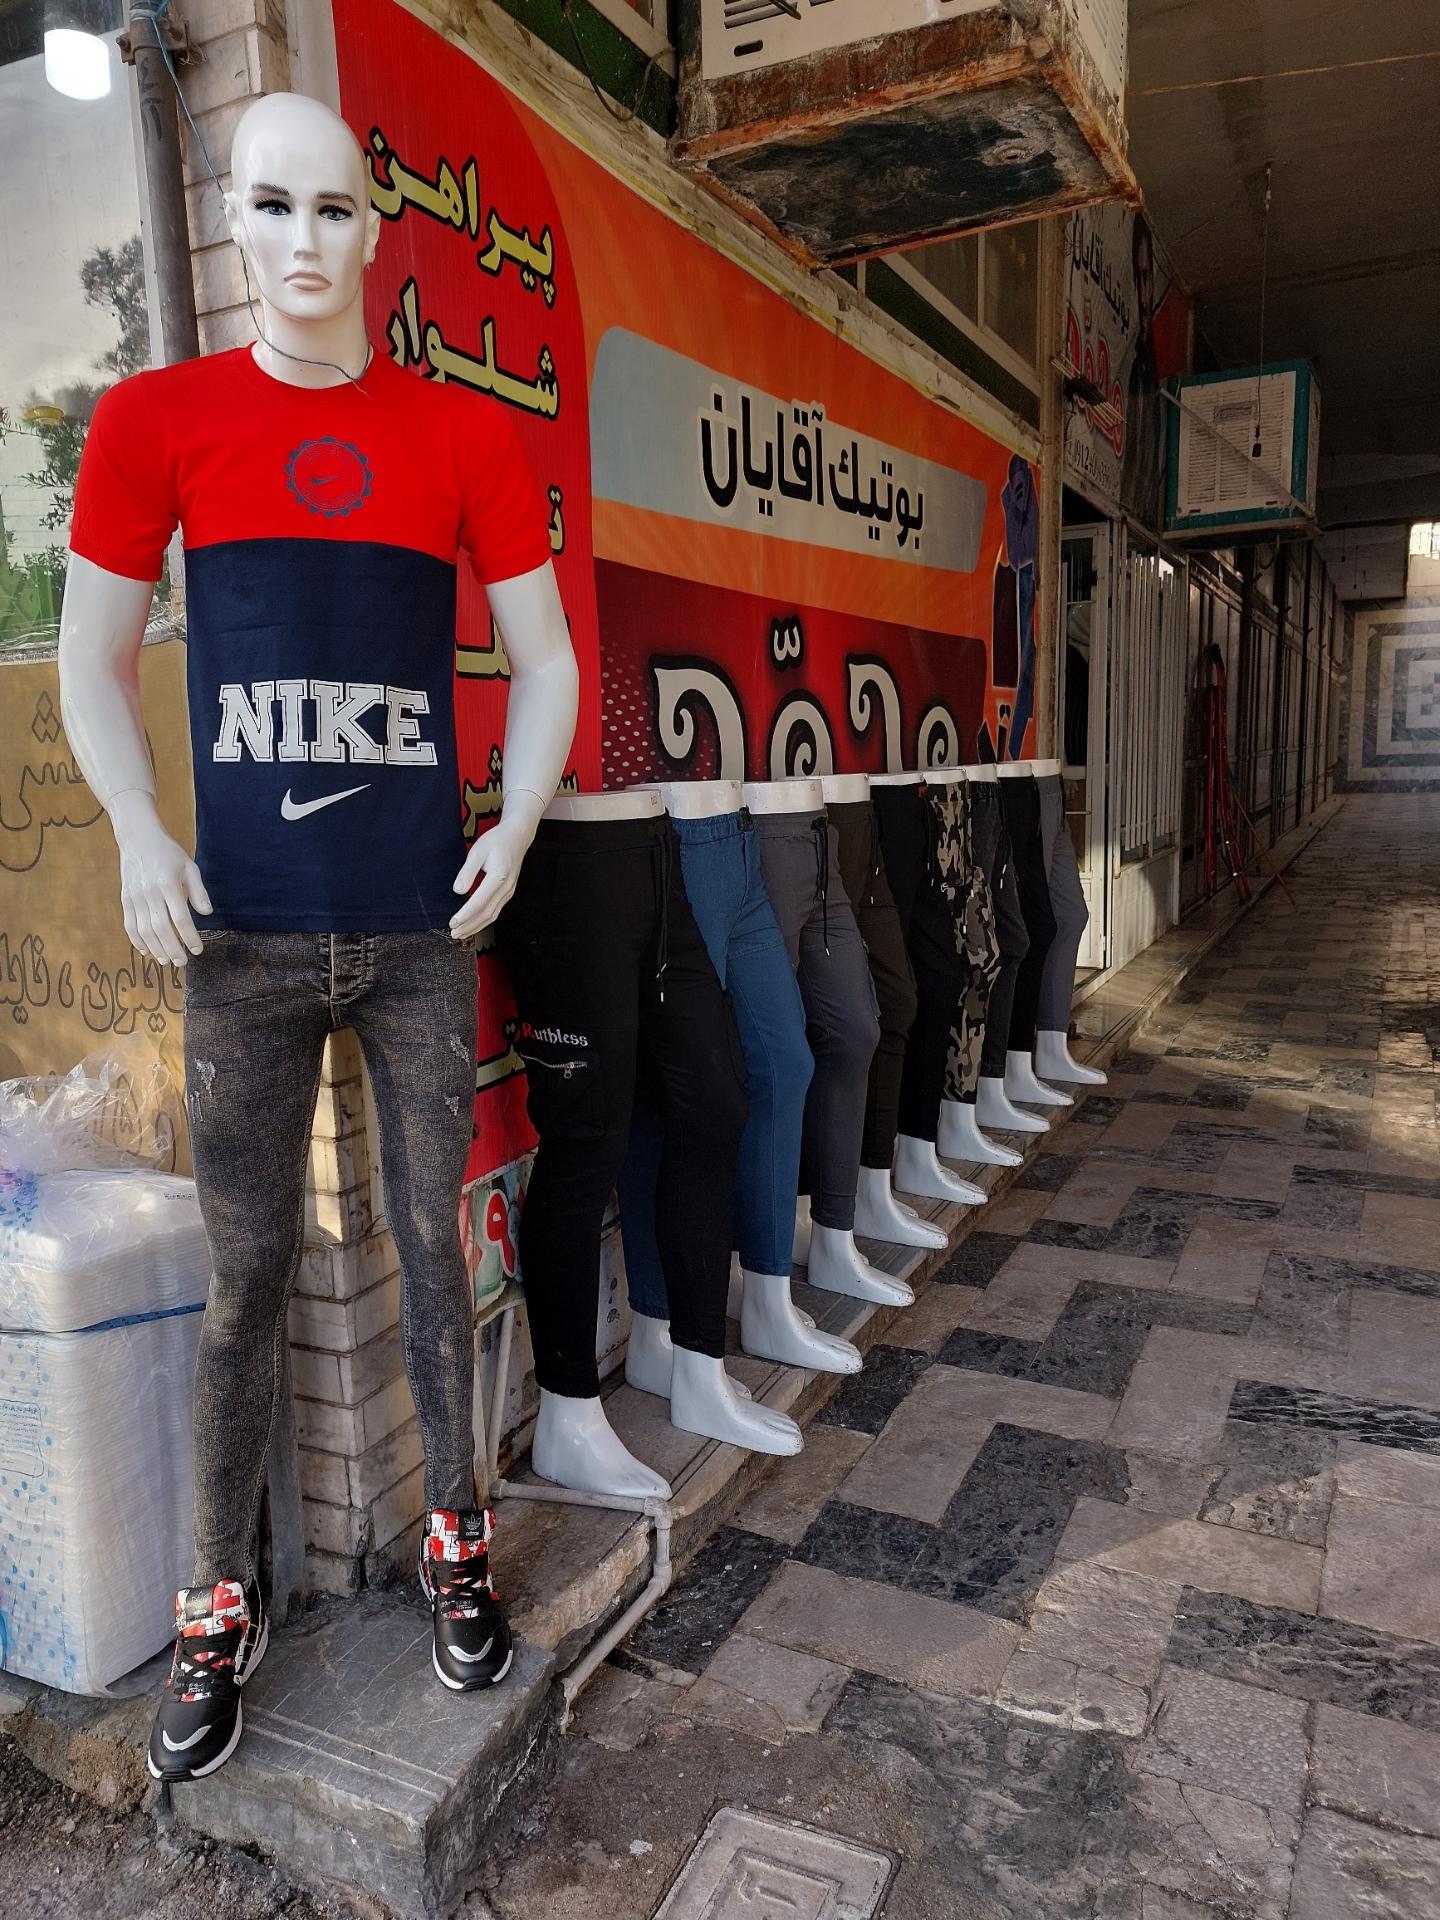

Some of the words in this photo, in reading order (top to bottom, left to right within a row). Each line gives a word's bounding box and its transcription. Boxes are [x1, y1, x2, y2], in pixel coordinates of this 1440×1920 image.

[364, 126, 556, 310] پیراهن
[386, 275, 560, 421] شلوار
[700, 393, 825, 517] آقایان
[212, 679, 439, 767] NIKE
[521, 1022, 589, 1047] Ruthless
